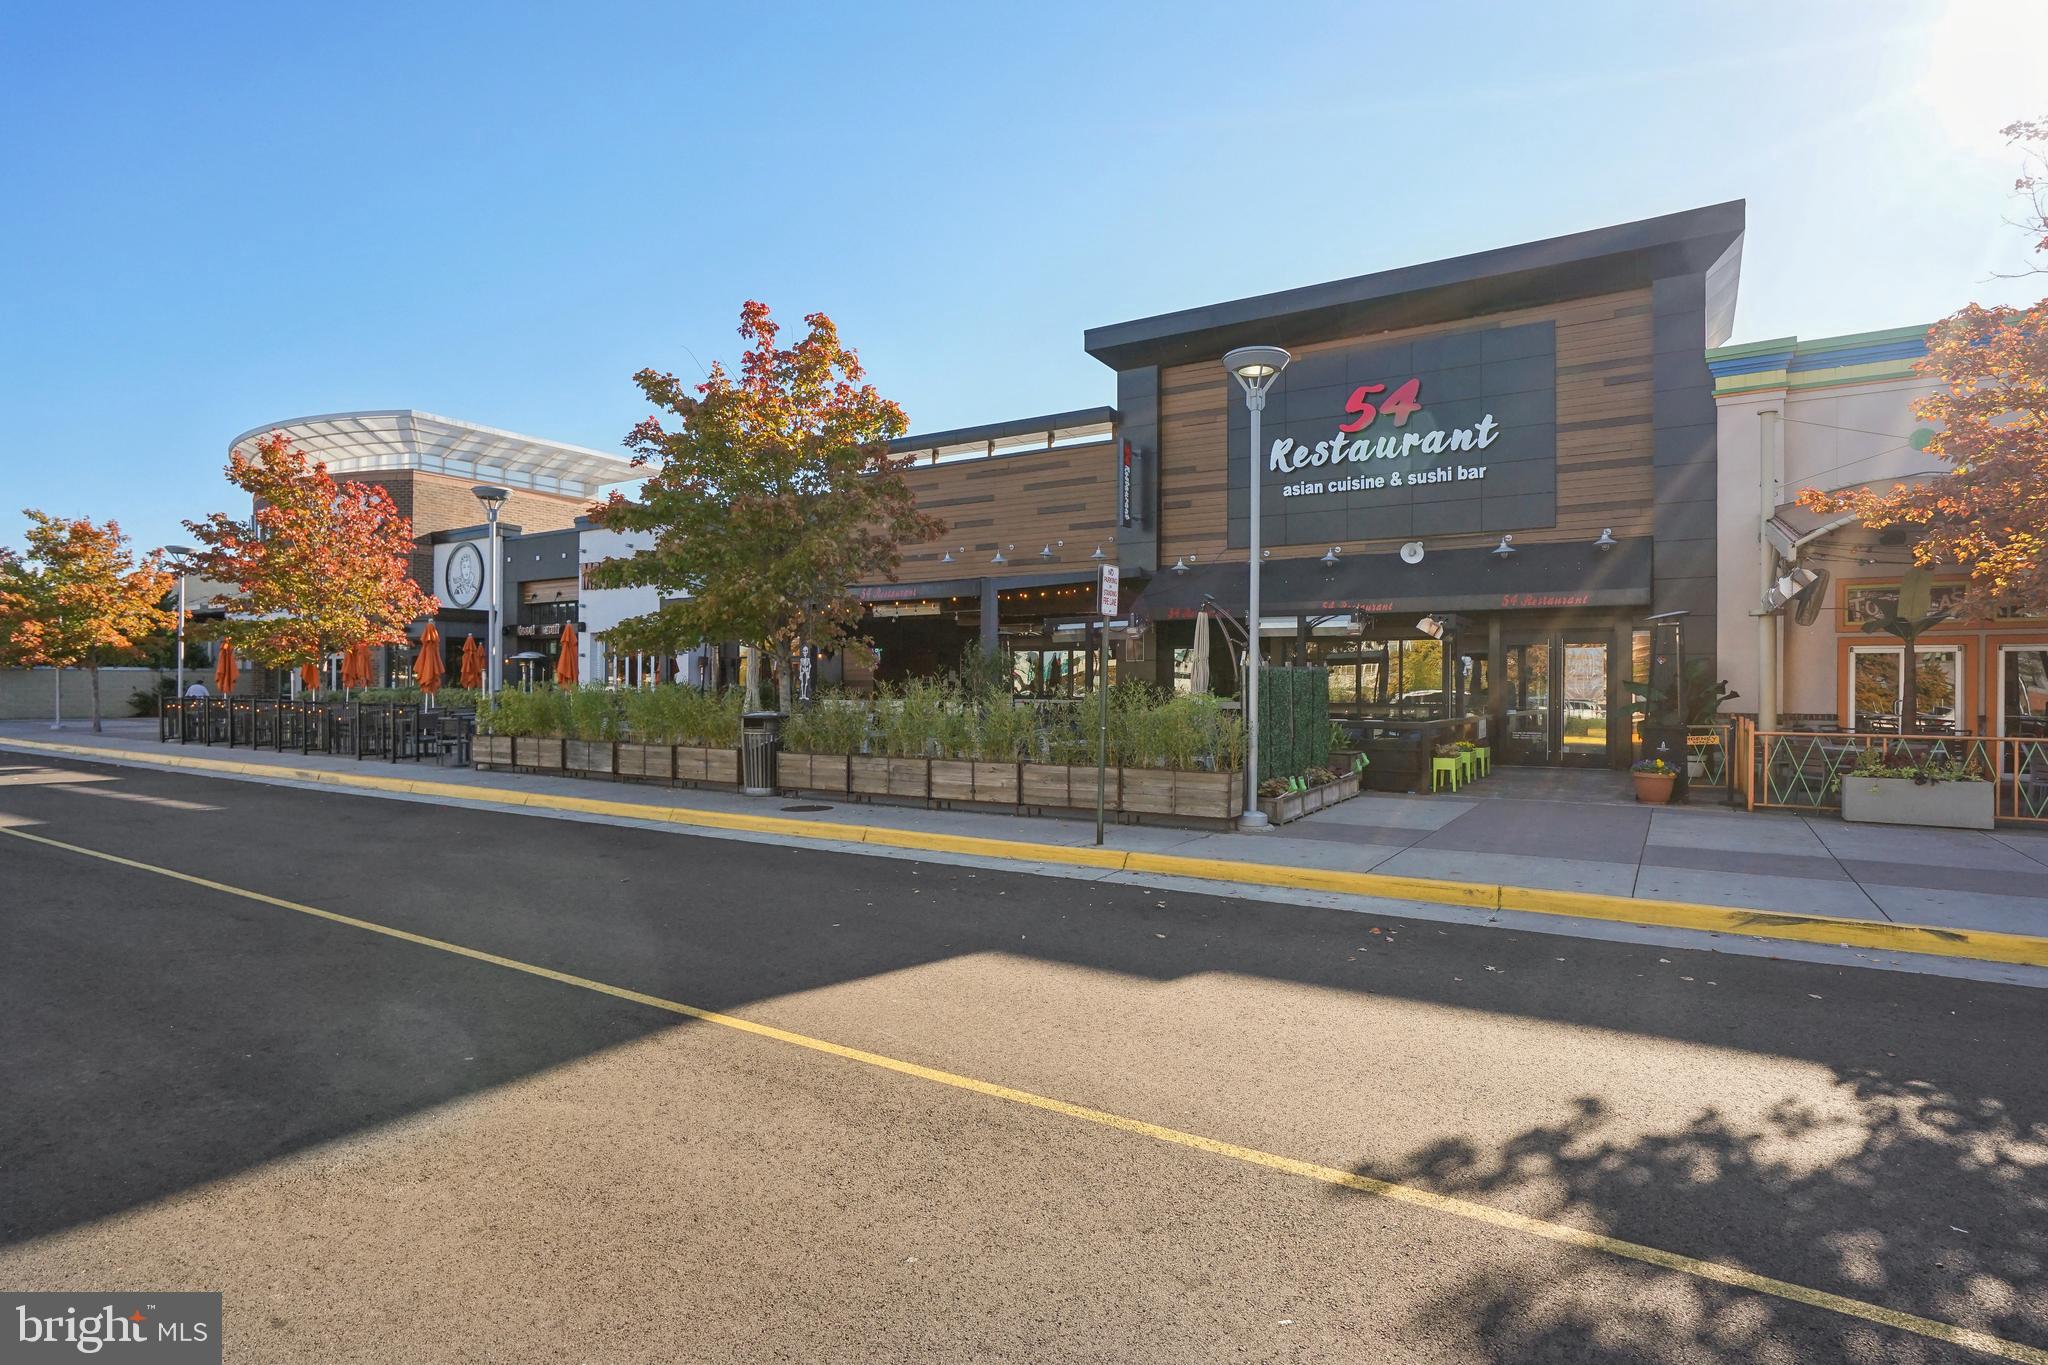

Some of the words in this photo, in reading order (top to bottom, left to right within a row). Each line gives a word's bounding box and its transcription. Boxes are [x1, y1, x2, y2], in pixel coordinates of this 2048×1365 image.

[1339, 377, 1422, 433] 54
[1270, 413, 1499, 473] Restaurant
[1283, 481, 1323, 497] asian
[1328, 475, 1384, 493] cuisine
[1390, 471, 1402, 487] &
[1408, 466, 1452, 485] sushi
[1457, 465, 1487, 480] bar
[1501, 594, 1518, 608] 54
[1520, 592, 1589, 607] Restaurant
